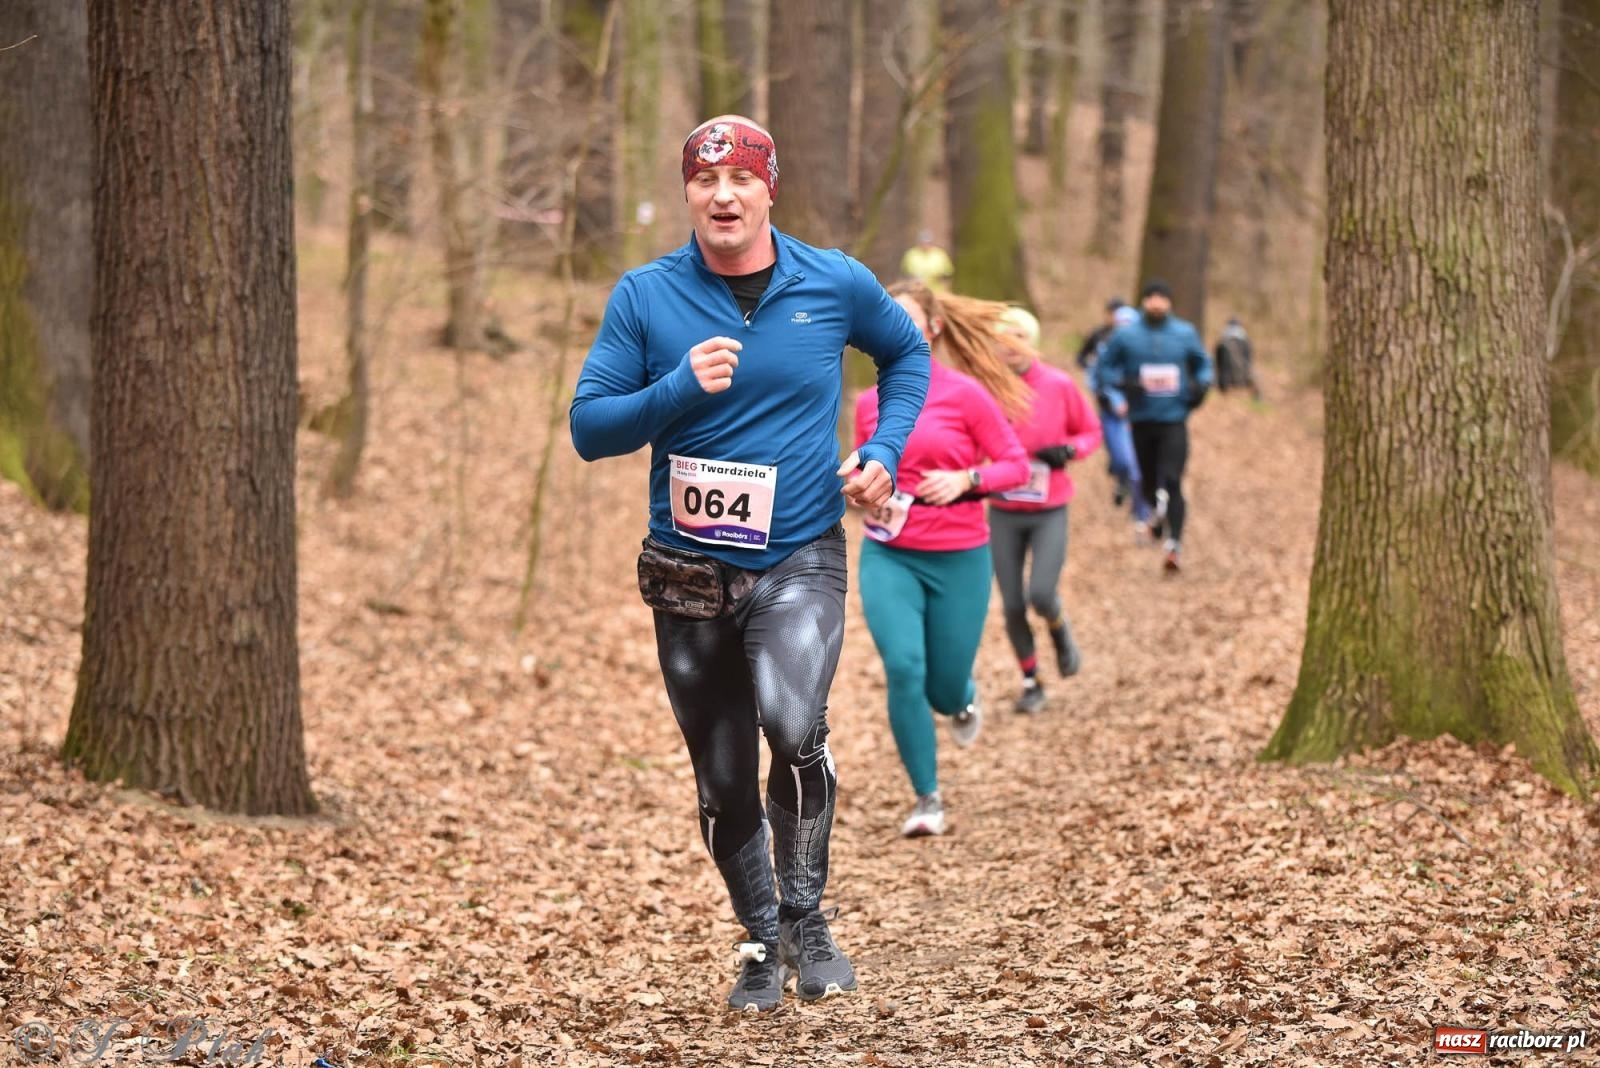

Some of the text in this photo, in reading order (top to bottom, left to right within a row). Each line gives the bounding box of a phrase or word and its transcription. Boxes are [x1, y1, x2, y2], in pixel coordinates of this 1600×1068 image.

[676, 460, 698, 471] BIEG
[700, 463, 767, 479] Twardziela
[684, 485, 751, 523] 064
